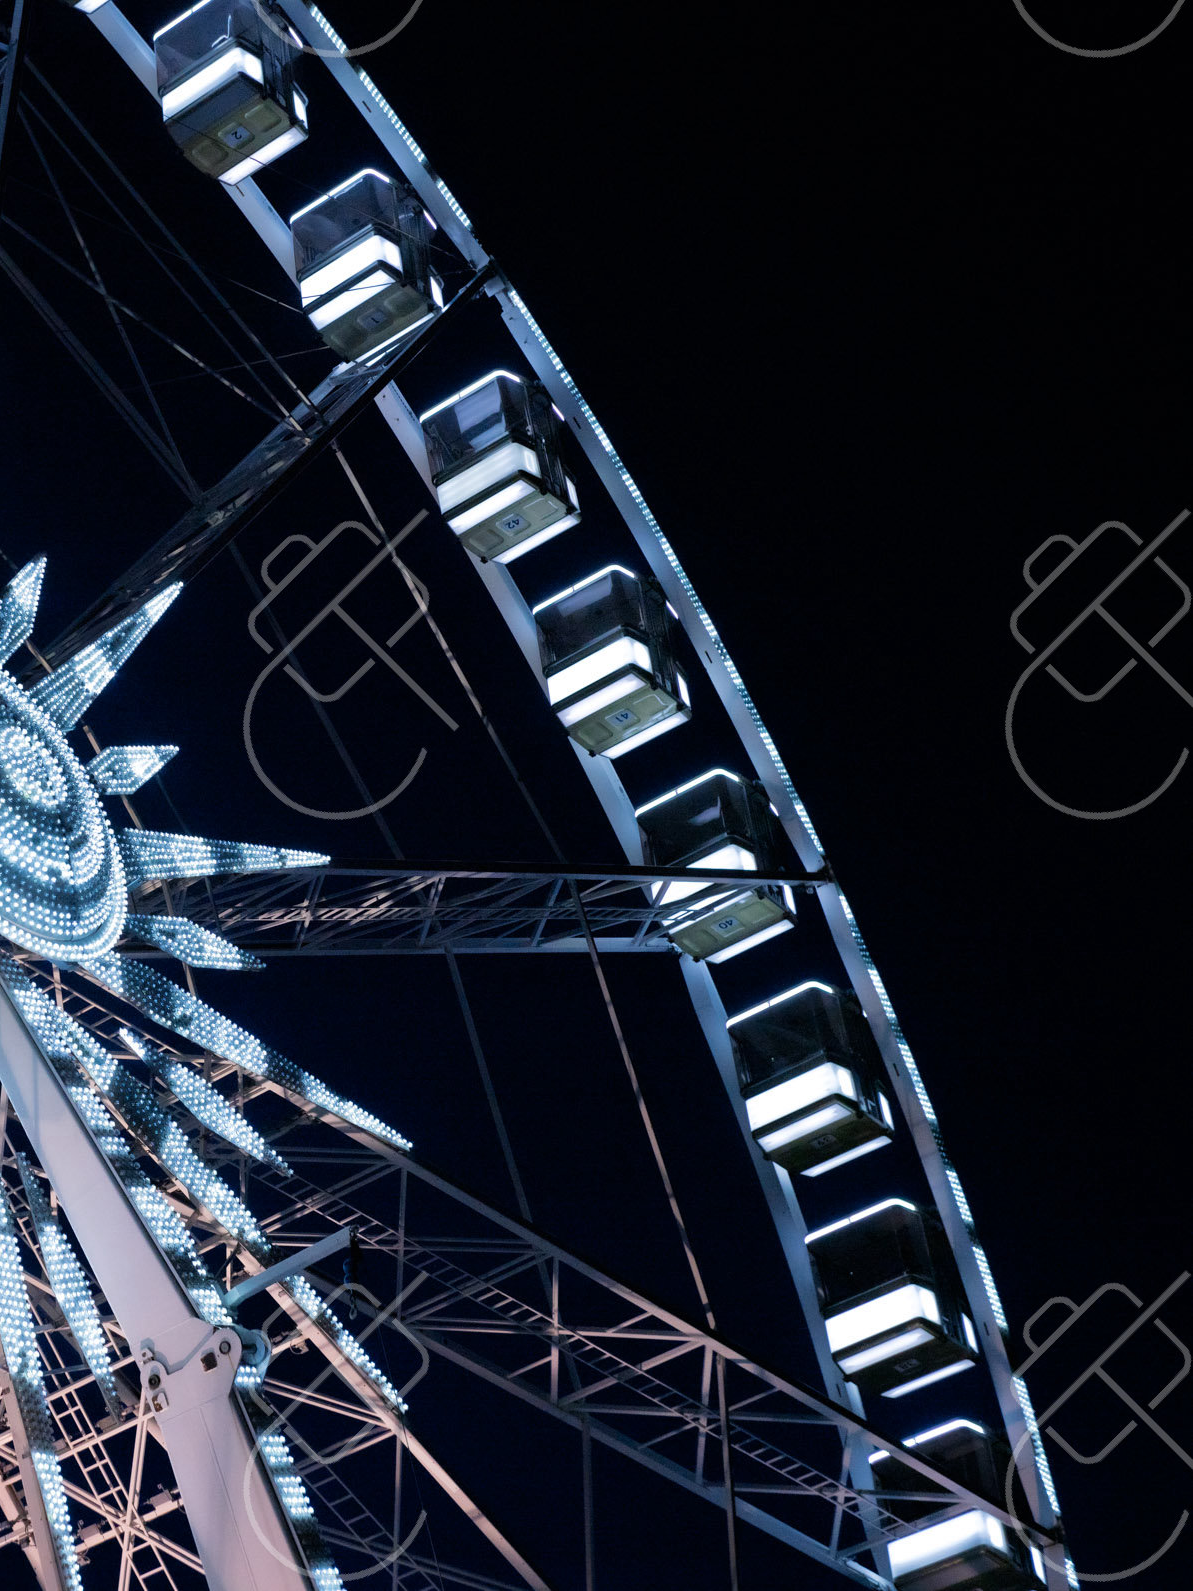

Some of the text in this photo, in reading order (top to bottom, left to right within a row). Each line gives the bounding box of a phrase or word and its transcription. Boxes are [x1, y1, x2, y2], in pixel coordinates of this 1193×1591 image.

[505, 519, 519, 529] 42
[615, 712, 628, 722] 41
[718, 919, 733, 929] 40
